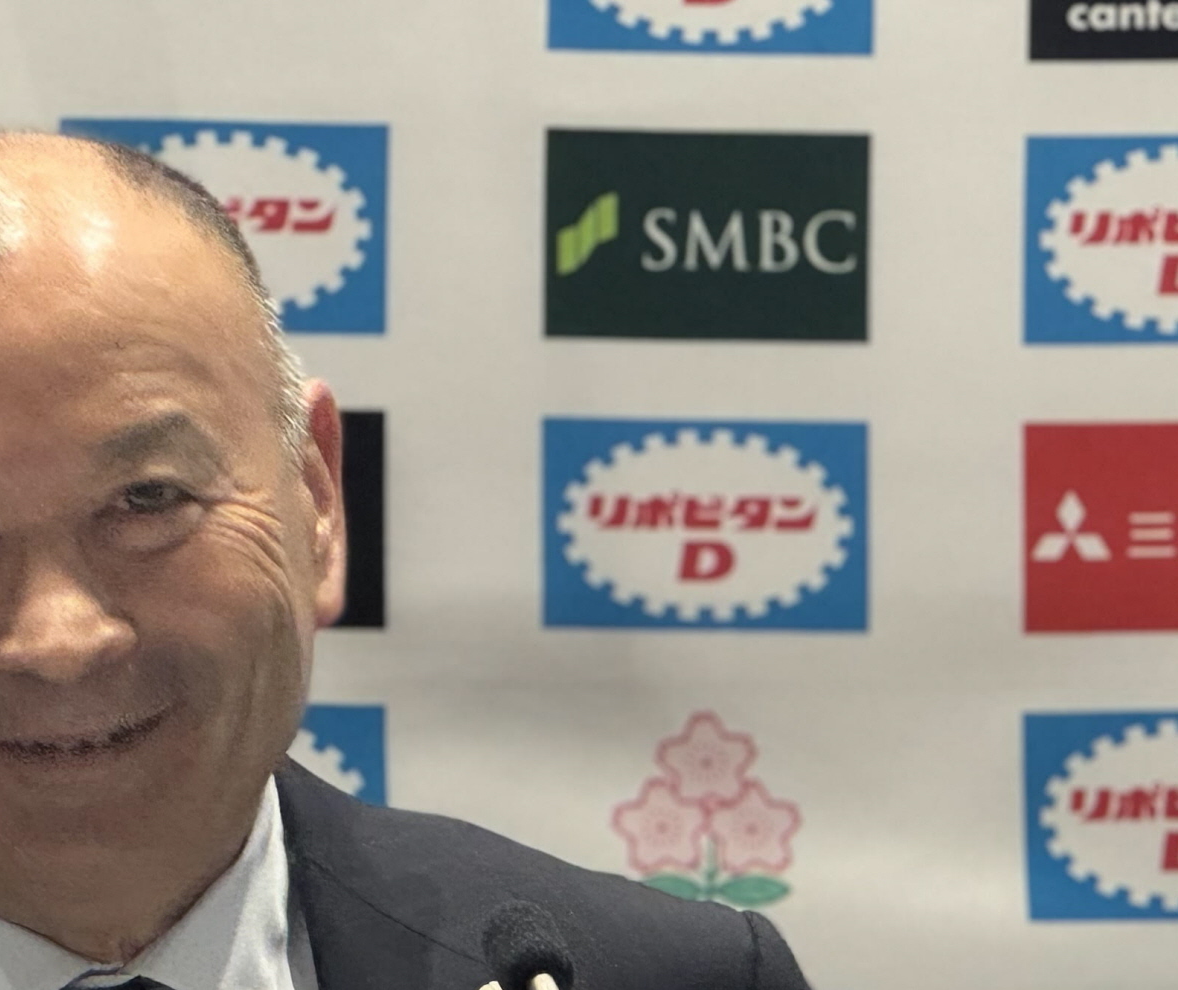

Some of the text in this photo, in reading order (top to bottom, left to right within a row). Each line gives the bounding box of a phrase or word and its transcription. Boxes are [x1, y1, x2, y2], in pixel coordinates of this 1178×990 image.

[641, 208, 858, 274] SMBC
[588, 491, 817, 530] リポビタン
[679, 541, 736, 582] D
